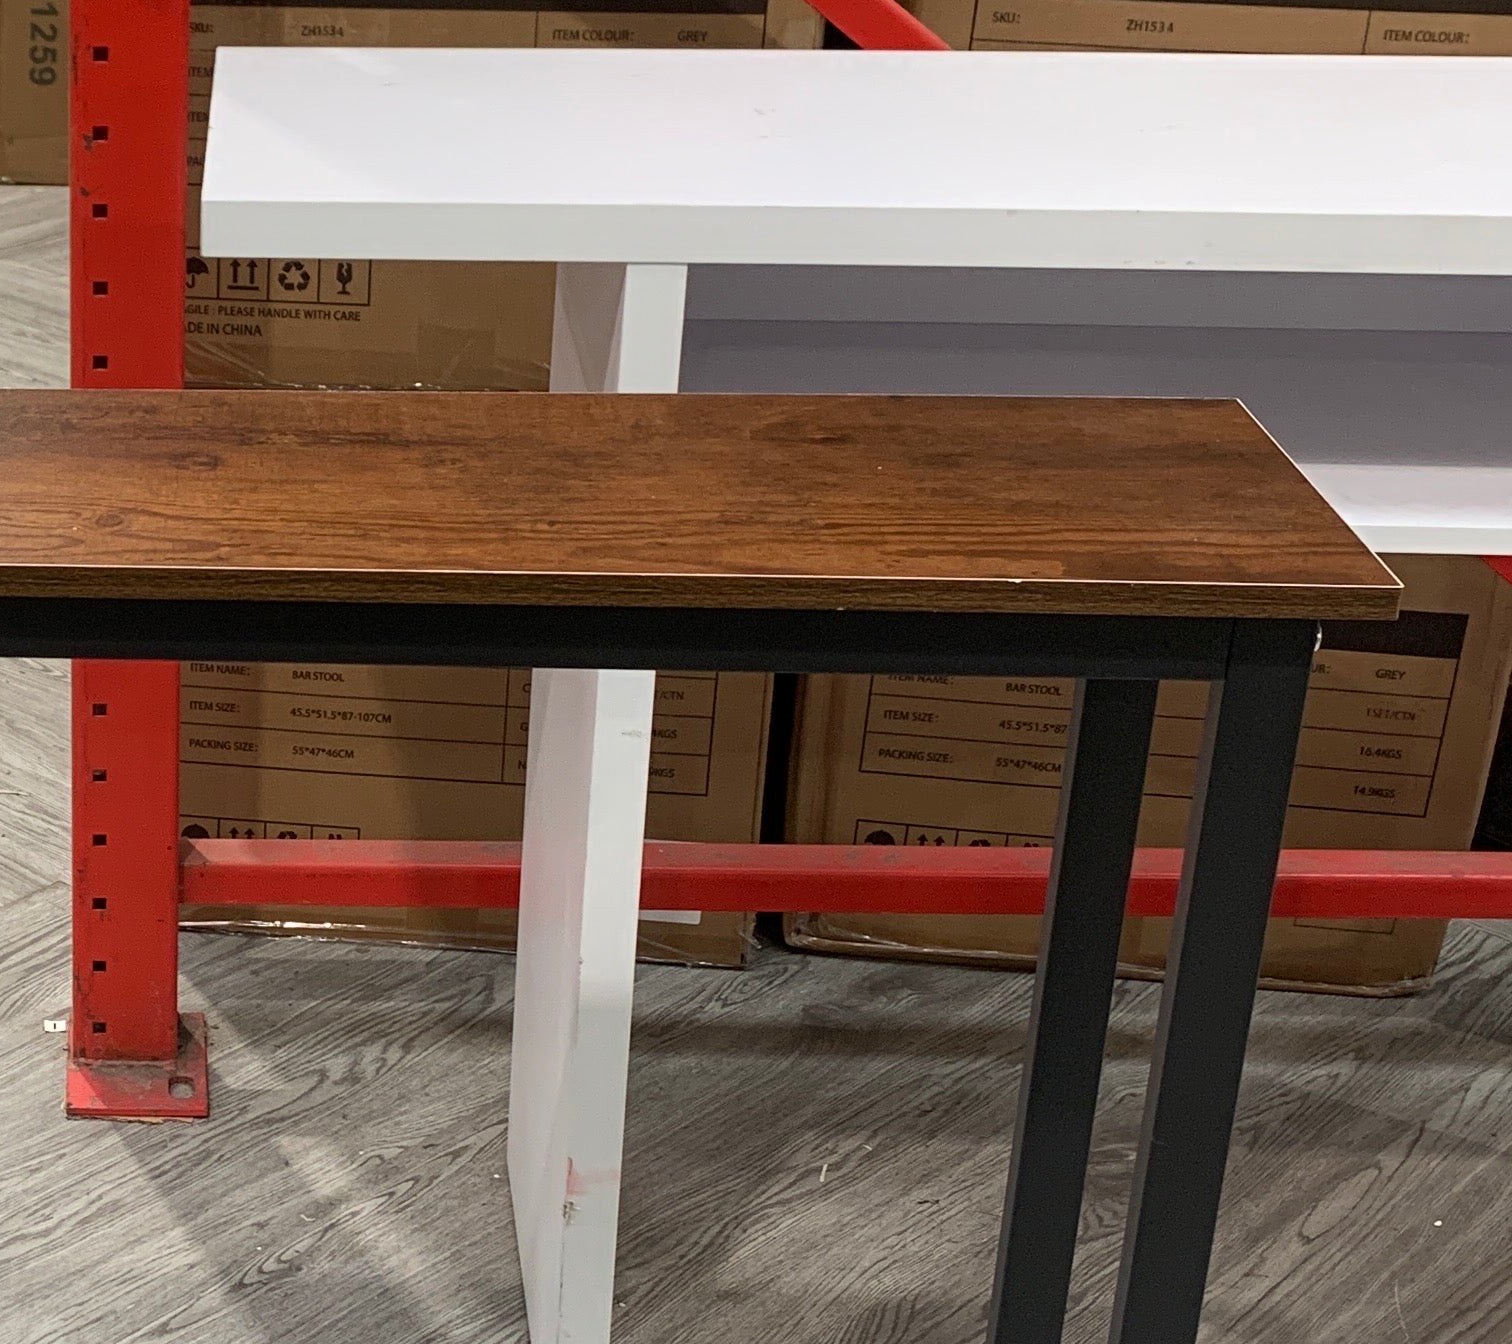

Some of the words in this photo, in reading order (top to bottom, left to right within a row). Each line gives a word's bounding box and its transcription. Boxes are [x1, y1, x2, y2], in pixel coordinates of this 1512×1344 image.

[991, 11, 1021, 24] SKU:
[551, 29, 580, 41] ITEM
[582, 29, 635, 42] COLOUR:
[677, 30, 708, 43] GREY
[1383, 29, 1412, 42] ITEM
[1413, 30, 1470, 44] COLOUR:
[217, 305, 255, 317] PLEASE
[257, 307, 301, 319] HANDLE
[303, 309, 332, 321] WITH
[333, 311, 361, 322] CARE
[206, 323, 220, 335] IN
[221, 323, 263, 337] CHINA
[190, 662, 215, 673] ITEM
[215, 664, 251, 676] NAME:
[1375, 667, 1407, 681] GREY
[292, 670, 312, 681] BAR
[312, 671, 345, 683] STOOL
[1005, 682, 1028, 693] BAR
[1028, 683, 1062, 697] STOOL
[189, 700, 214, 712] ITEM
[214, 701, 240, 713] SIZE:
[883, 709, 911, 722] ITEM
[911, 710, 939, 724] SIZE:
[188, 738, 232, 752] PACKING
[233, 740, 260, 753] SIZE:
[878, 747, 926, 762] PACKING
[926, 752, 954, 764] SIZE:
